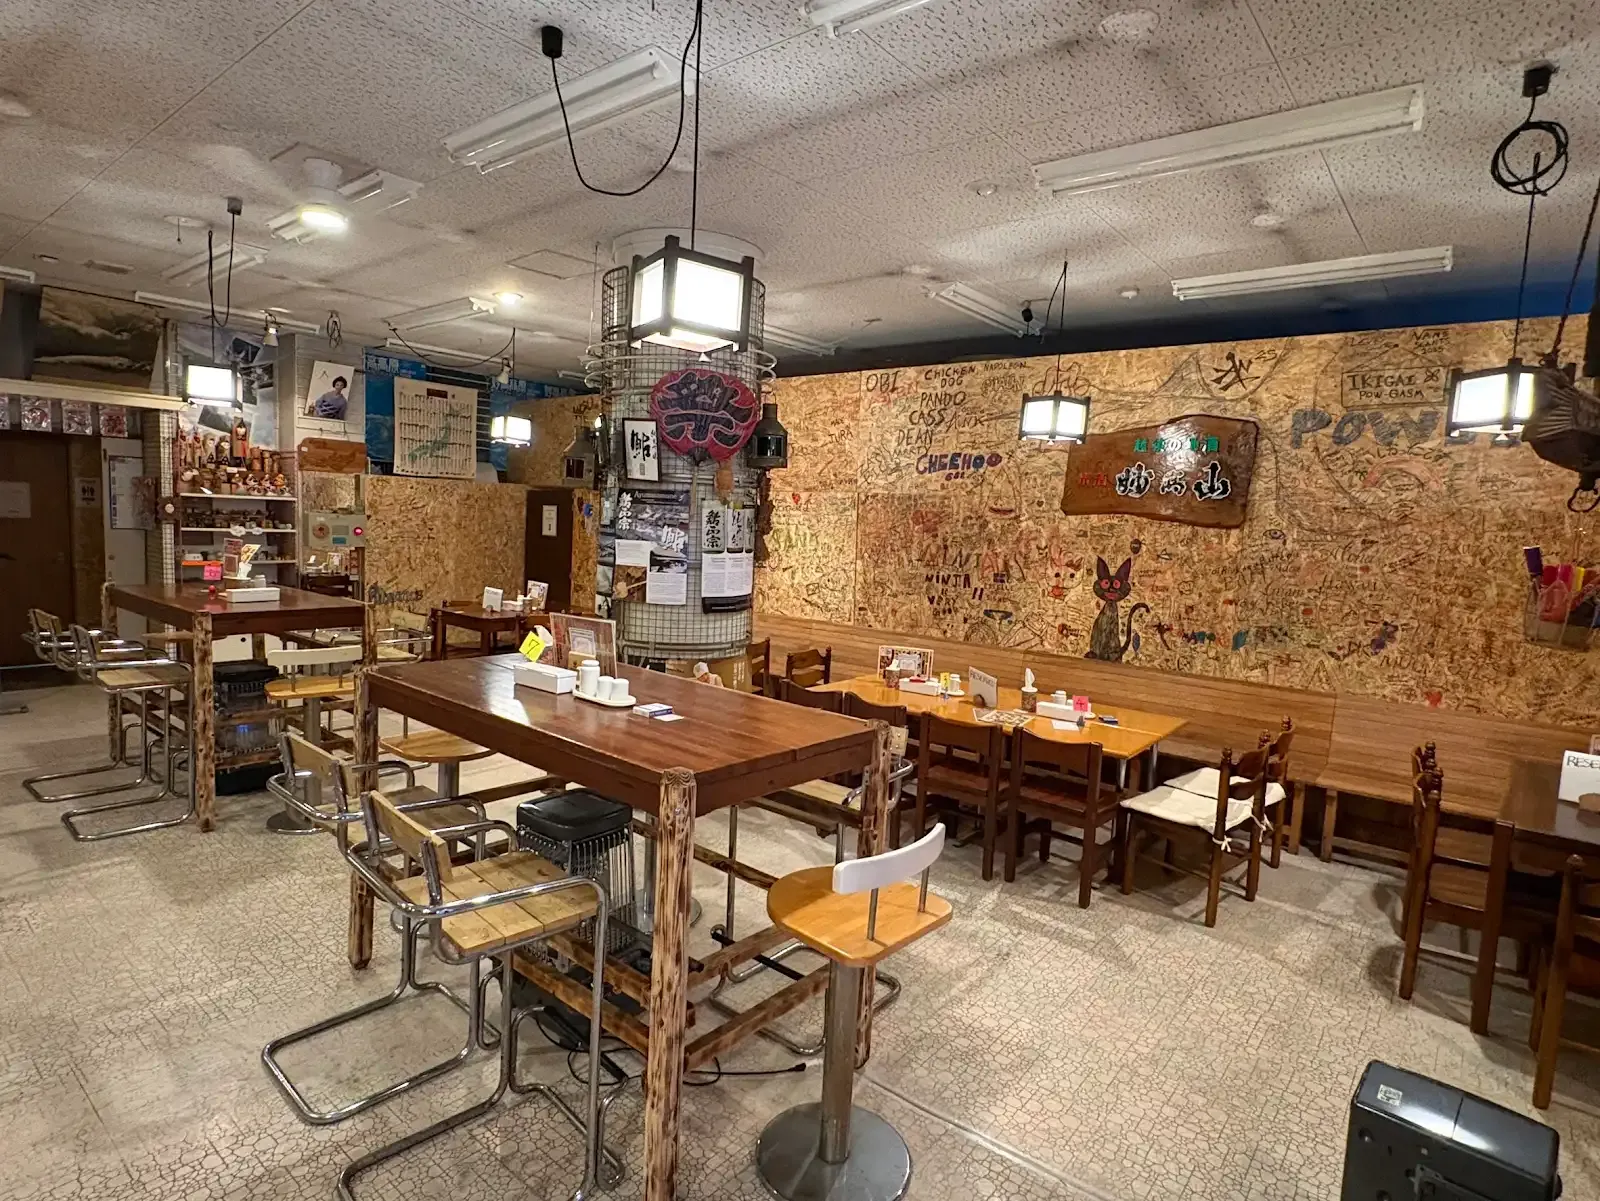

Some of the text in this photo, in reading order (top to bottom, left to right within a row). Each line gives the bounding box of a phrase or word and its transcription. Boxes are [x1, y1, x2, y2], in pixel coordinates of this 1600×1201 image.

[866, 370, 900, 394] OBI
[924, 365, 977, 381] CHICKEN
[1347, 373, 1417, 391] IKIGAI
[940, 377, 964, 389] DOG
[919, 391, 968, 409] PANDO
[908, 407, 948, 428] CASS
[897, 427, 933, 447] DEAN
[526, 638, 541, 655] 7
